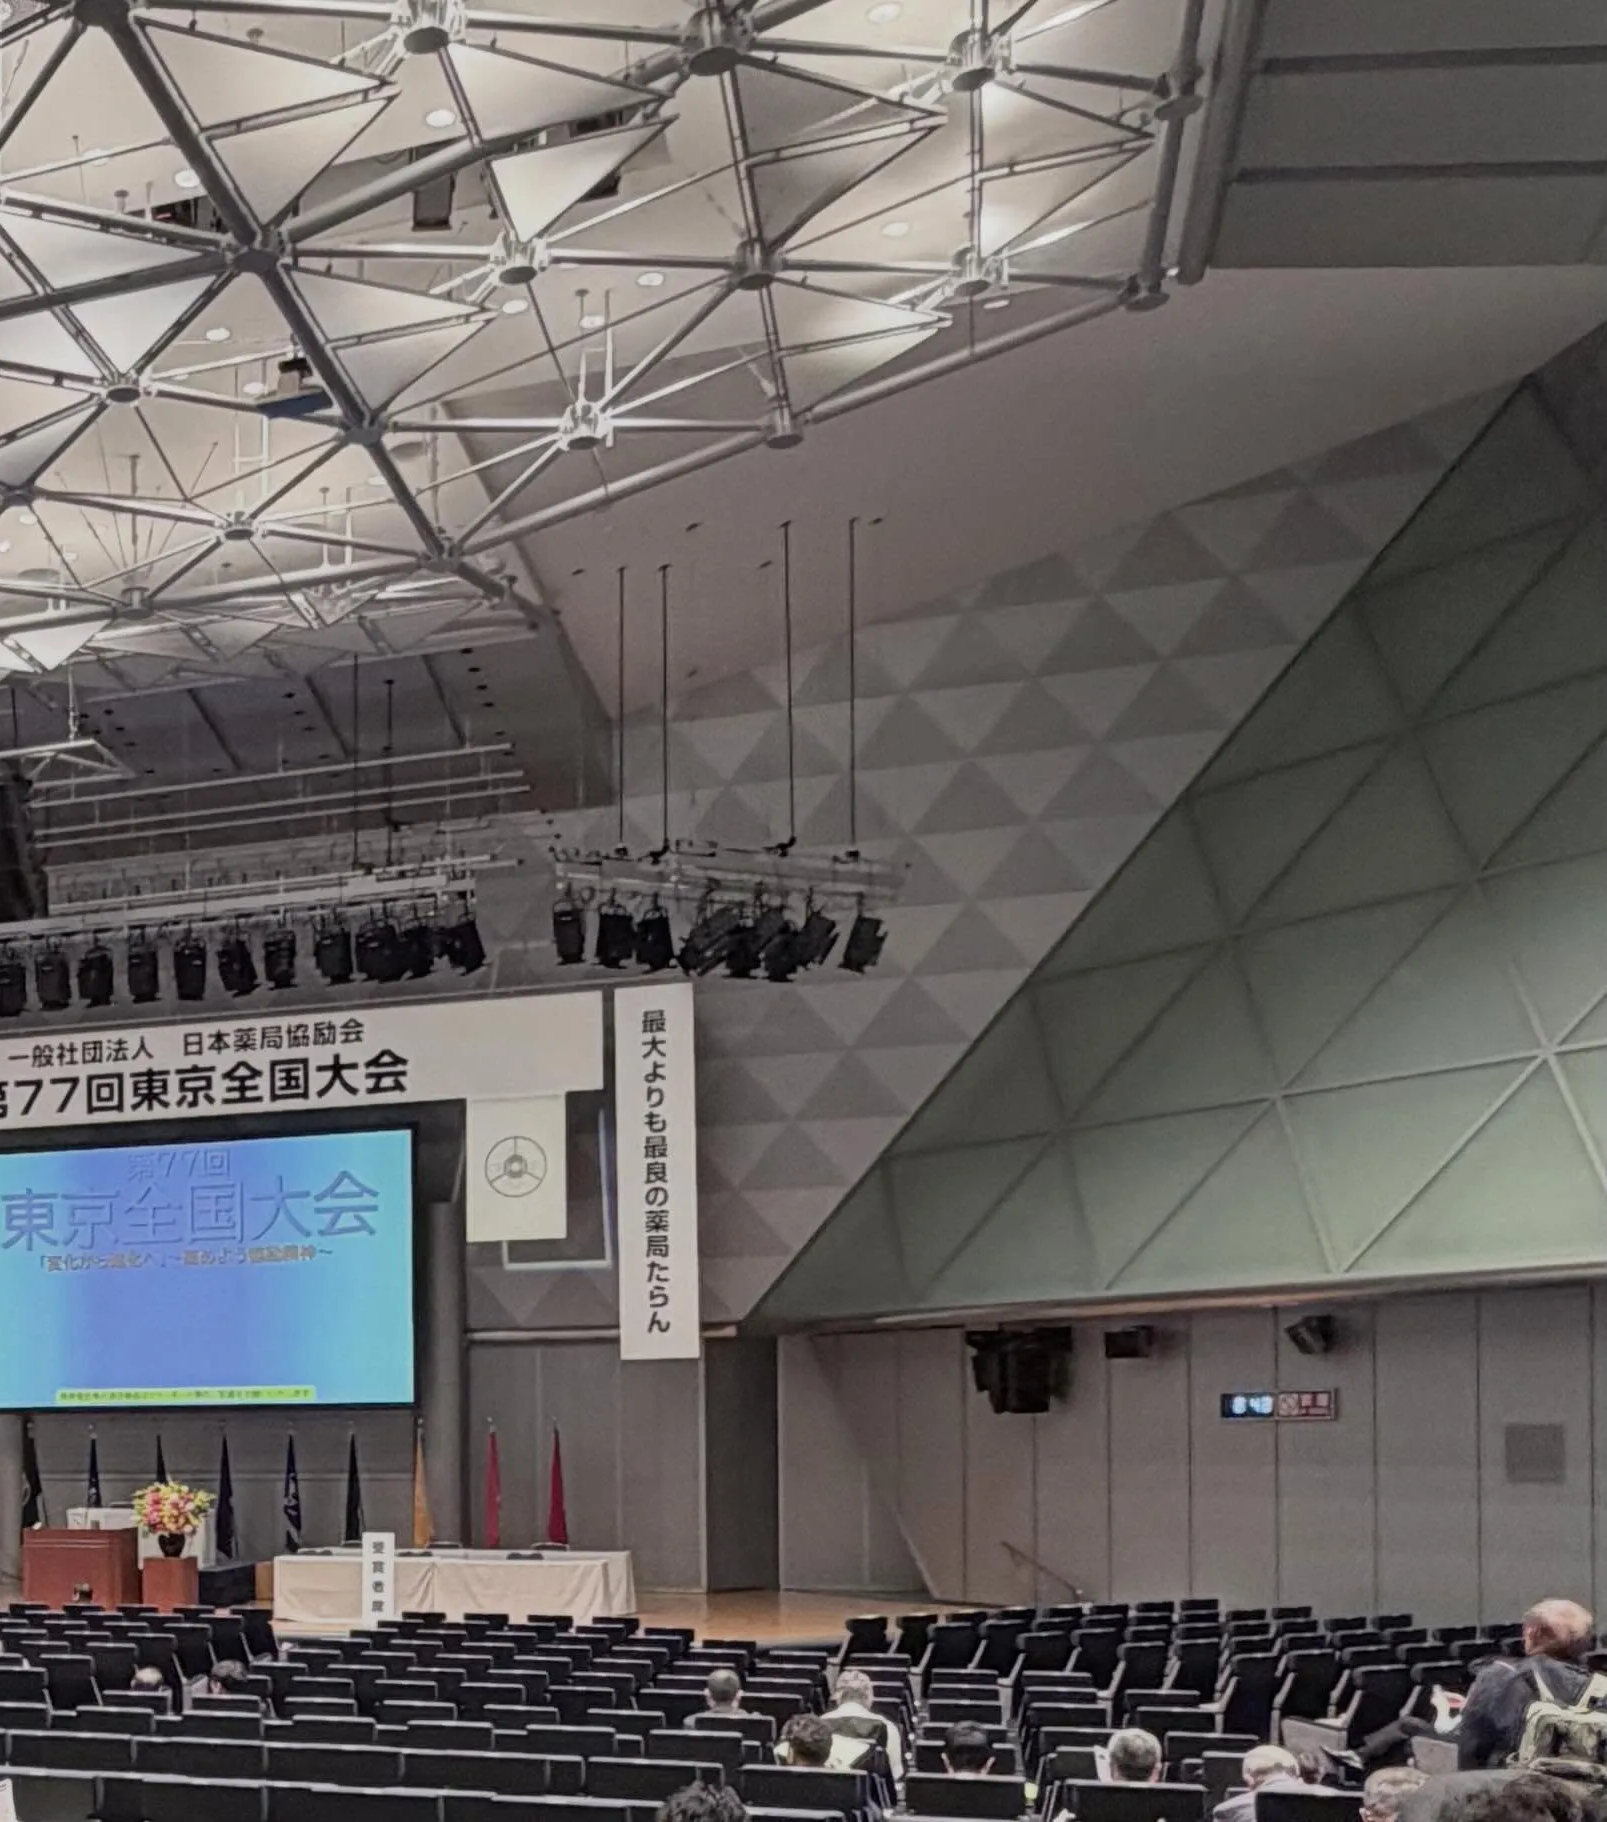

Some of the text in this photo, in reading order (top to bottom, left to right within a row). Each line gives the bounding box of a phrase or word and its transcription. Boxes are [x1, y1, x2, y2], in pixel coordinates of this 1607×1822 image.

[8, 1018, 364, 1067] 一般社団法人 日本薬局協励会
[127, 1149, 231, 1183] 第77回
[642, 1009, 670, 1334] 最大よりも最良の薬局たらん
[1, 1170, 379, 1252] 東京全国大会
